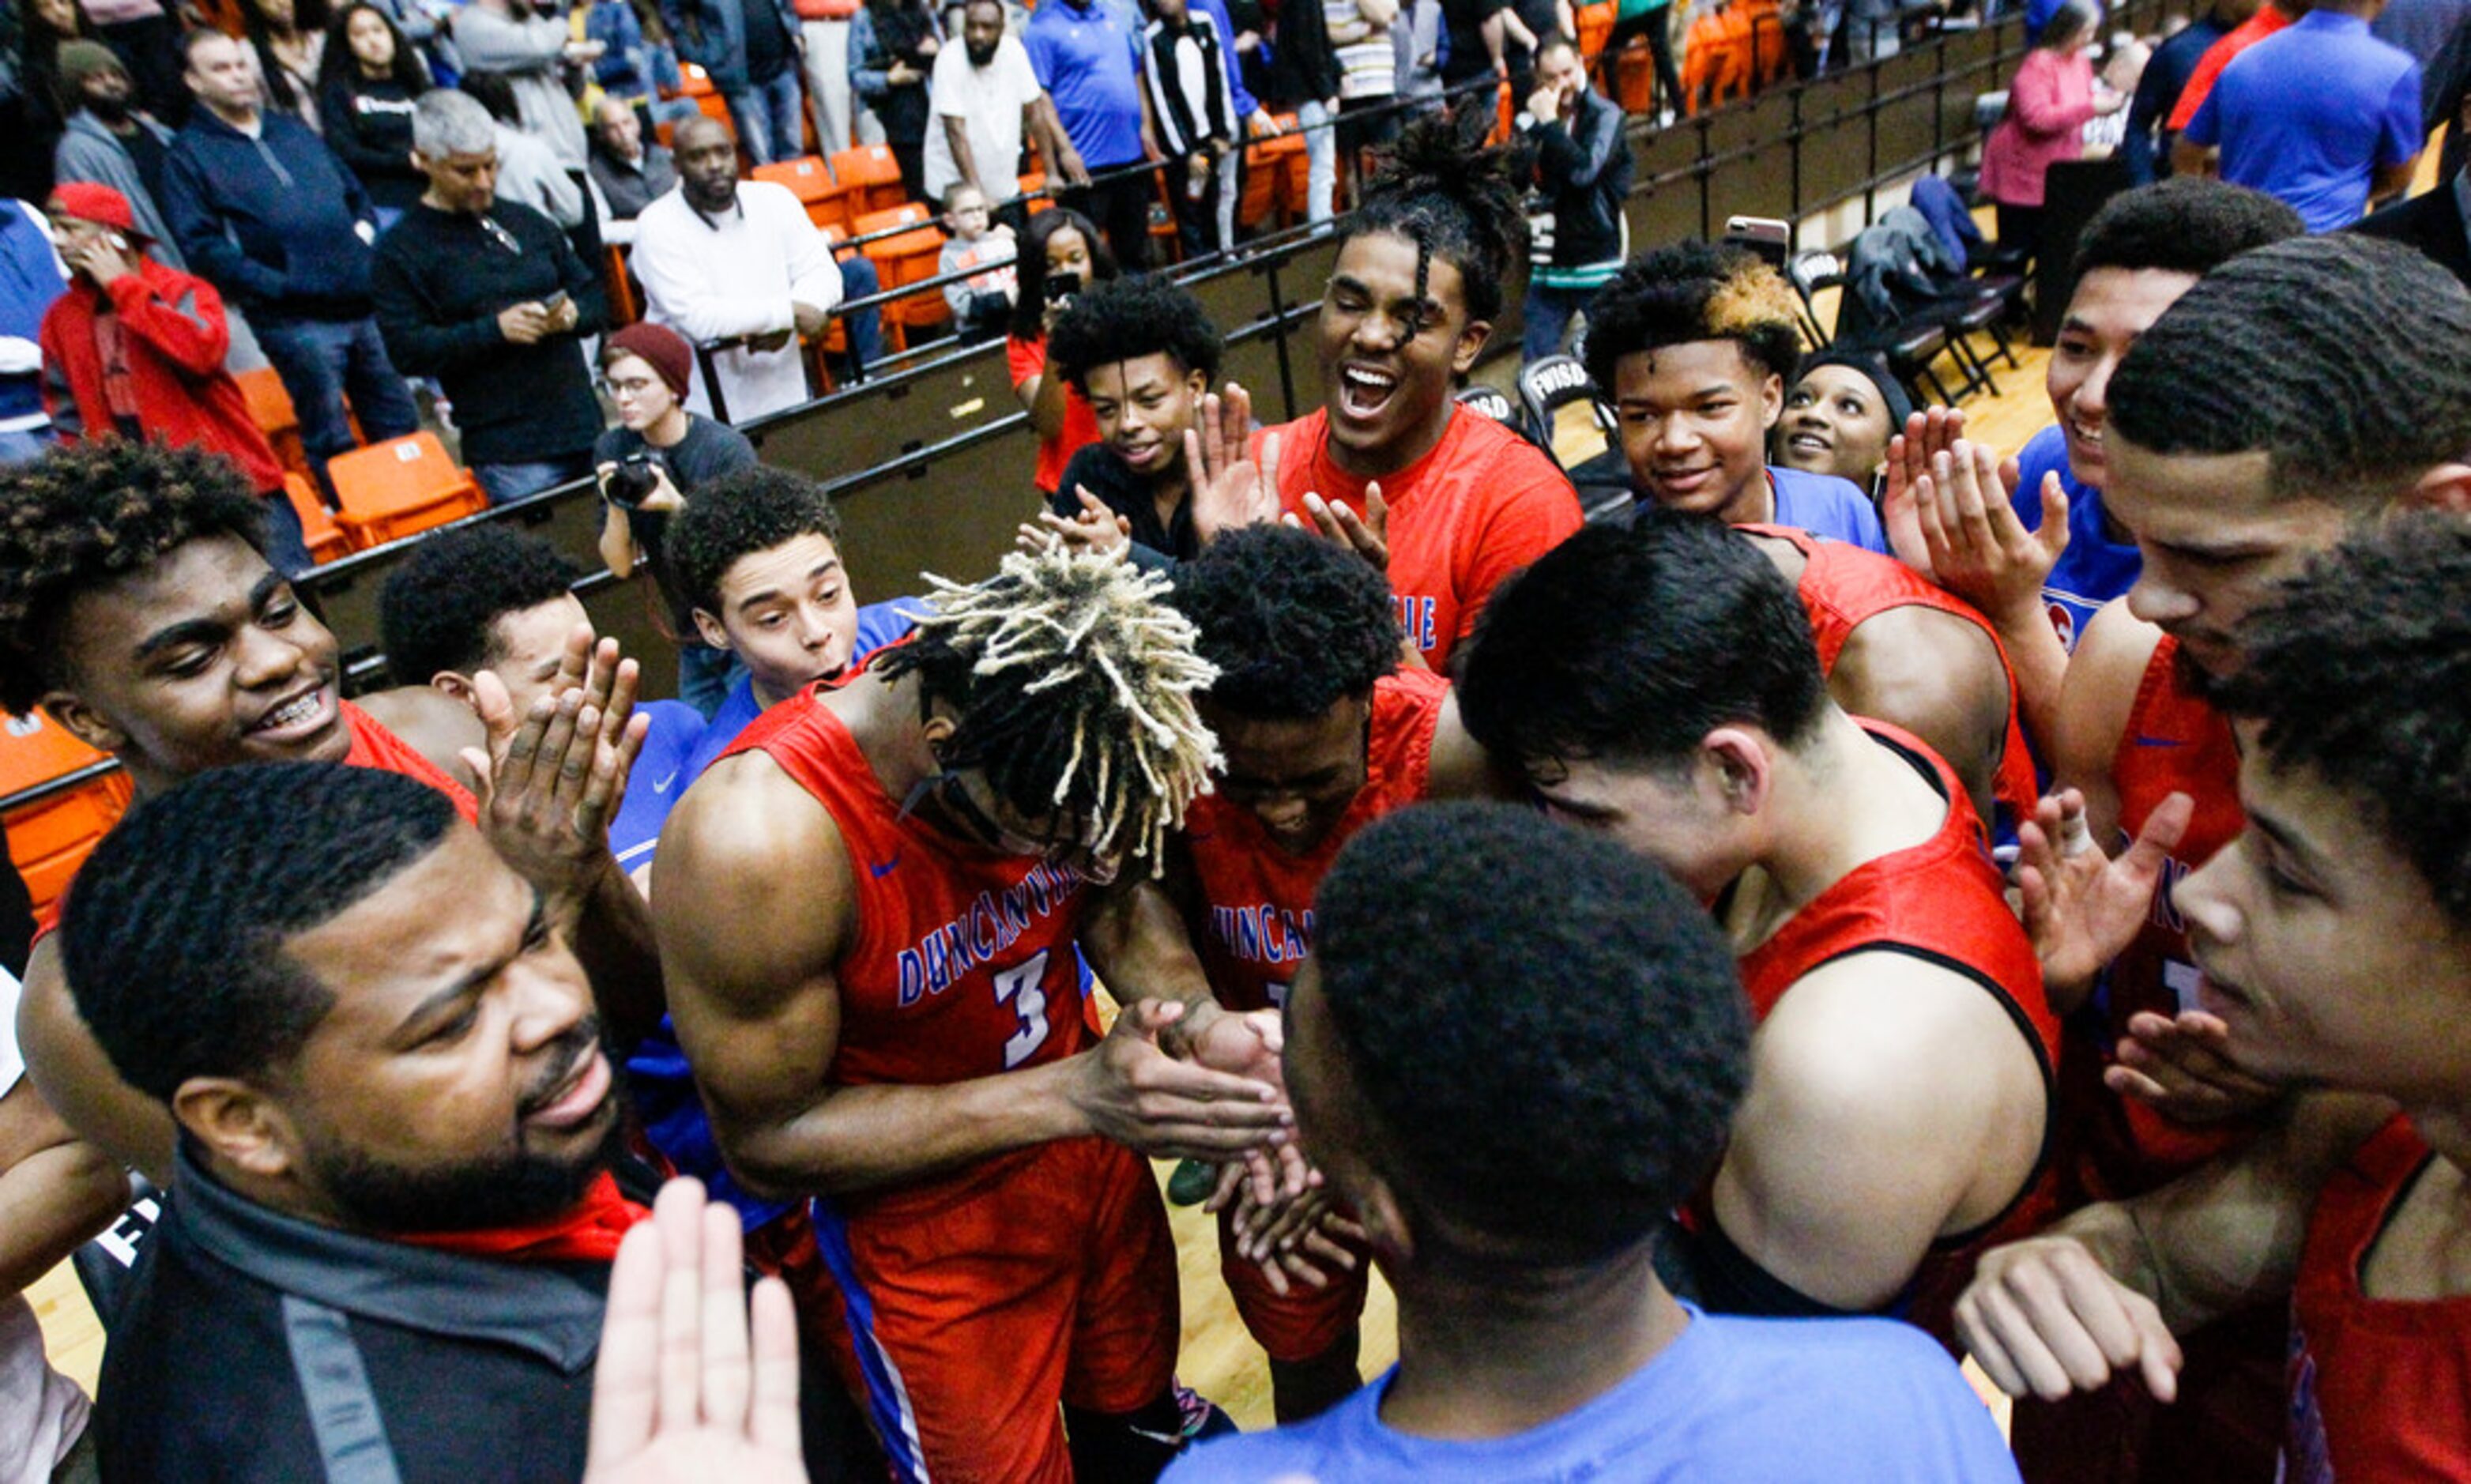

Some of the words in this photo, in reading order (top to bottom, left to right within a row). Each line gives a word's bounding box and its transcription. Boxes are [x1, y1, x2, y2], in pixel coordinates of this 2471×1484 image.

[1530, 361, 1587, 401] FWISD
[1391, 595, 1437, 650] LE
[897, 858, 1079, 1008] DUNCANVIL
[1211, 902, 1313, 963] UNCA
[994, 947, 1049, 1070] 3
